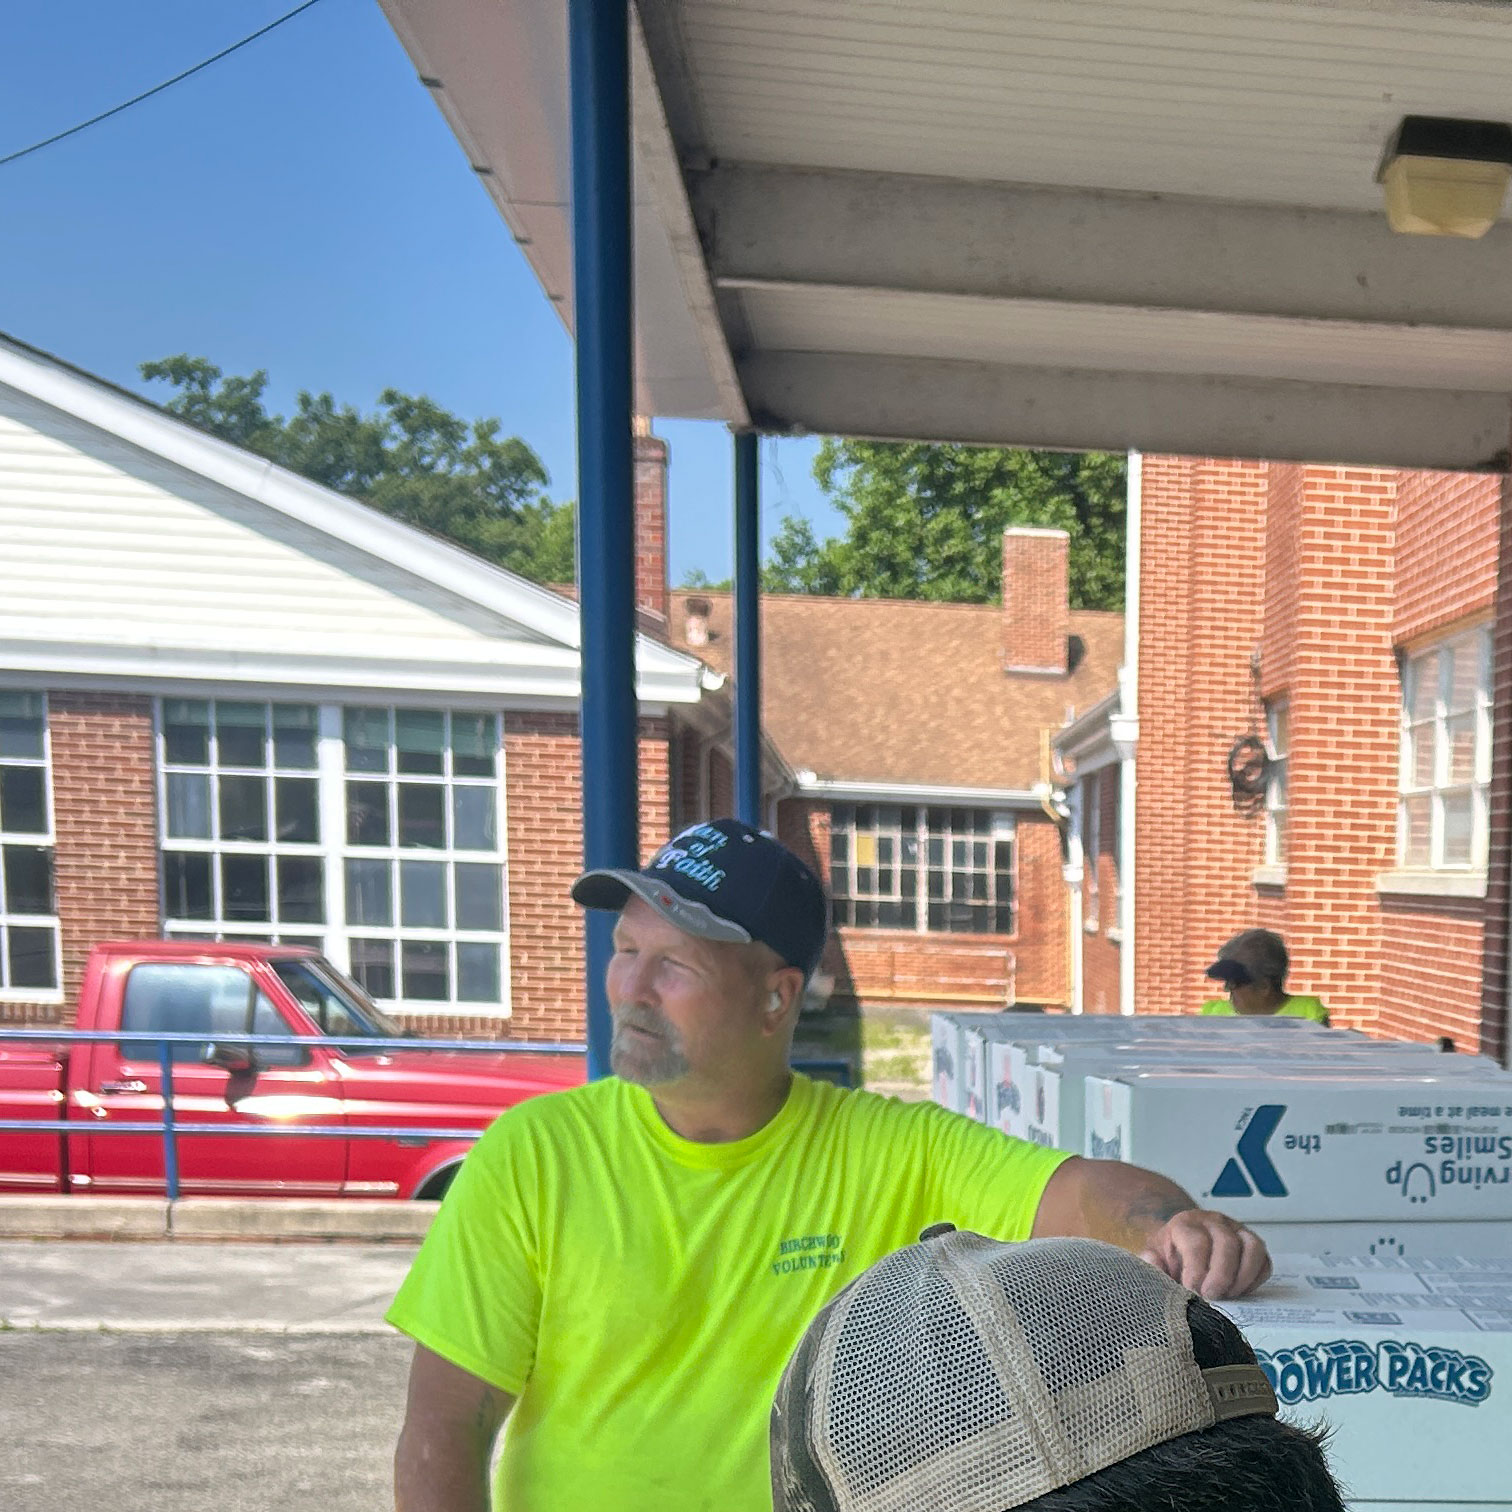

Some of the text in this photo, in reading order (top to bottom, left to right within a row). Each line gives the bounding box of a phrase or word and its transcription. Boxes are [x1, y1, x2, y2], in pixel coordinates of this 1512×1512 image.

[1398, 1106, 1432, 1121] time
[1435, 1106, 1445, 1118] a
[1448, 1106, 1463, 1119] at
[1466, 1106, 1501, 1121] meal
[1284, 1134, 1320, 1154] the
[1425, 1136, 1512, 1160] Smiles
[1376, 1340, 1494, 1402] PACKS
